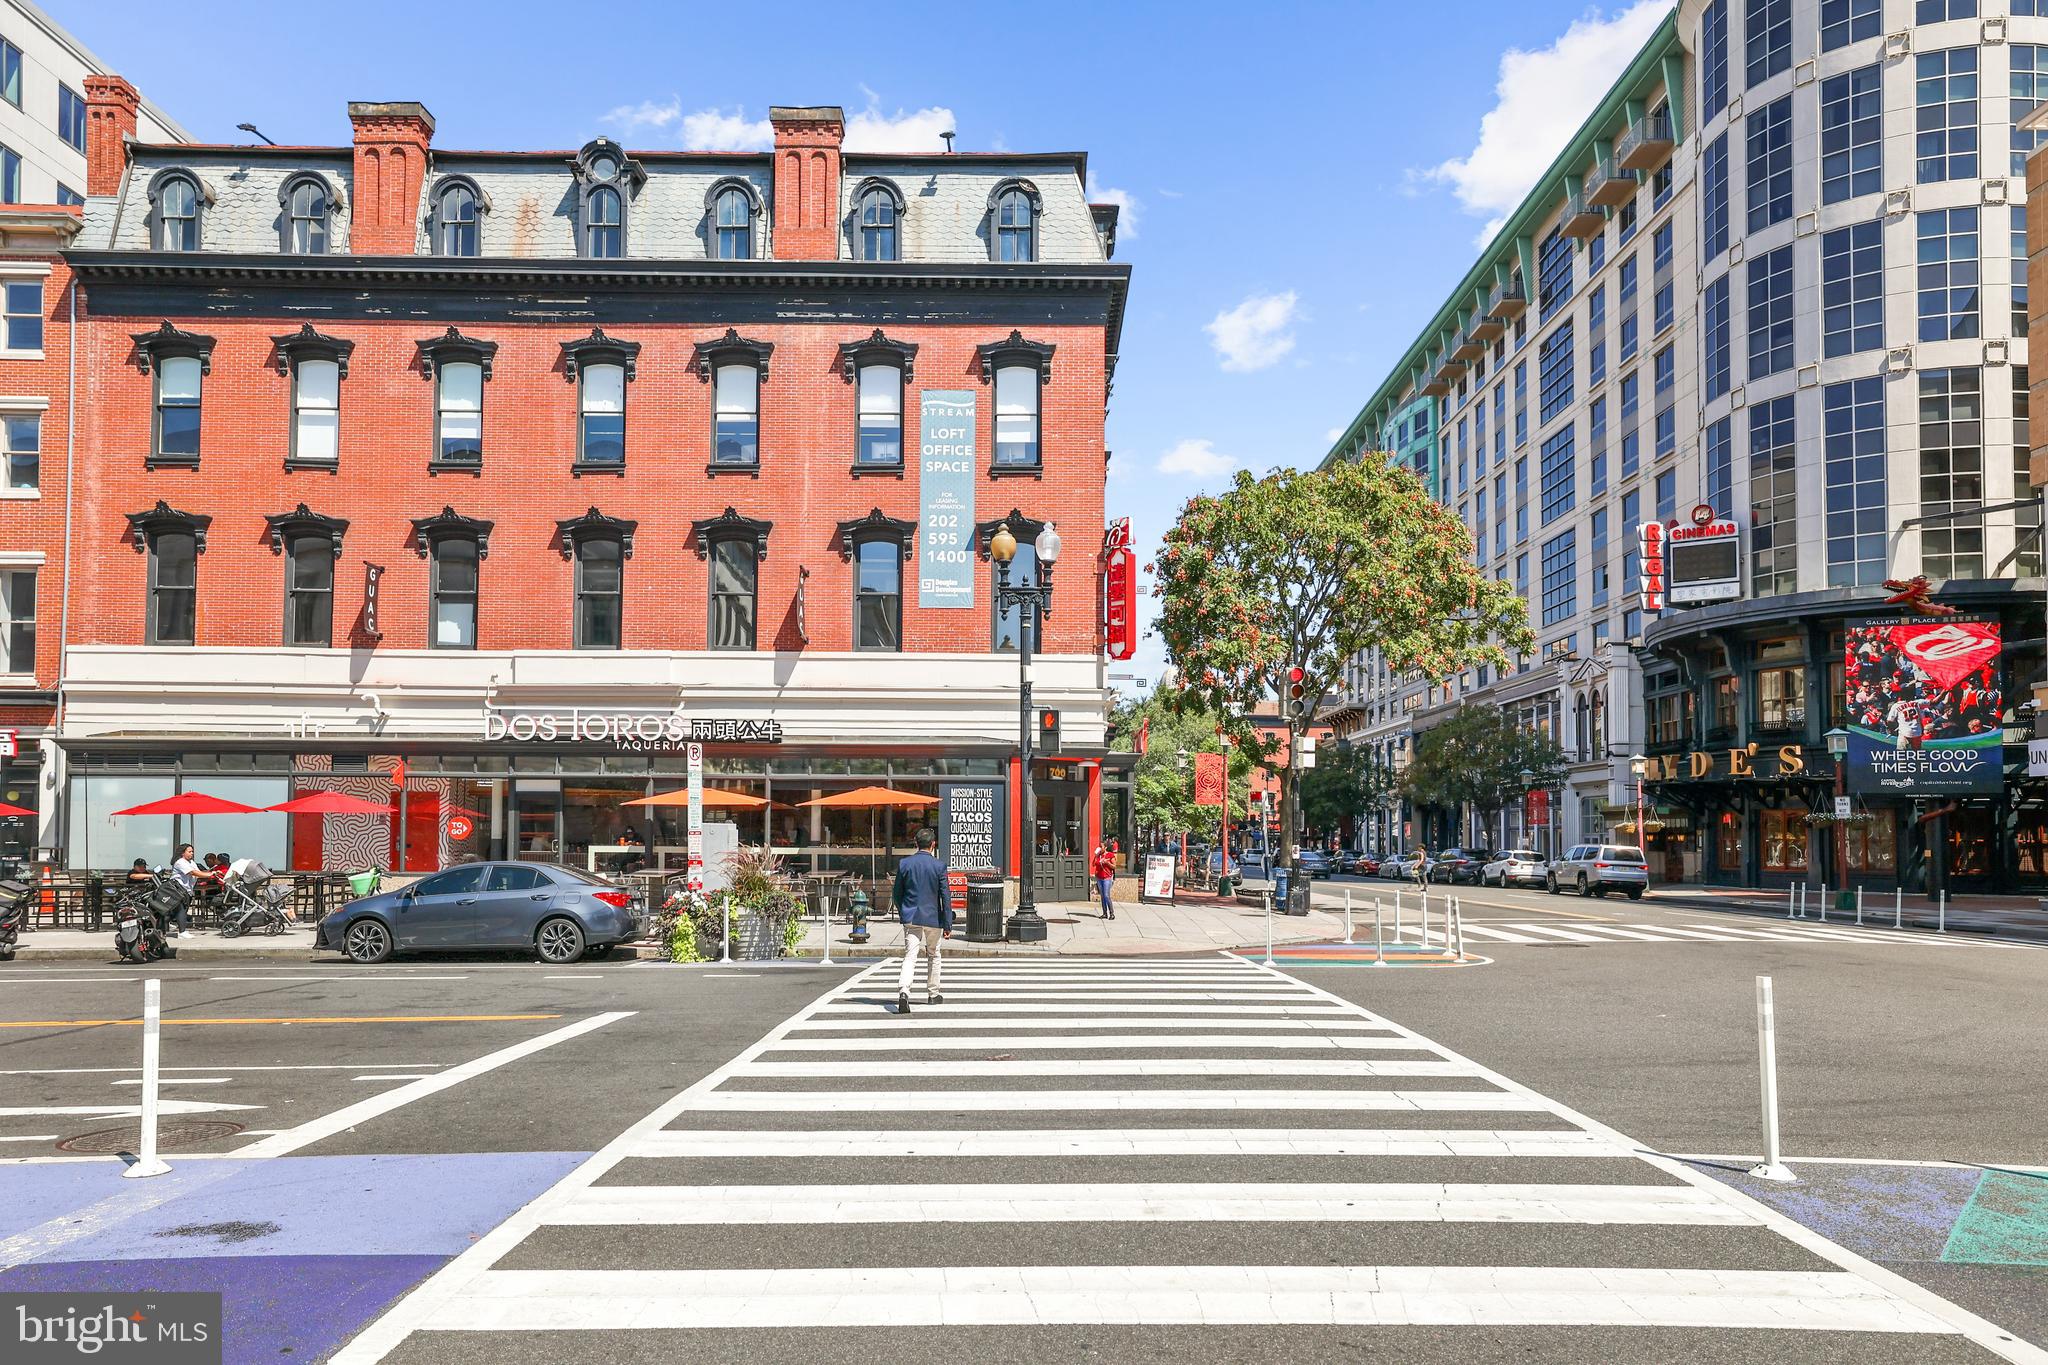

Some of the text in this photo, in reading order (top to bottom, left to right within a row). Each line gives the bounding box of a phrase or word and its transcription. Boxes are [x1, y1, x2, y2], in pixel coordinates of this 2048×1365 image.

[921, 408, 975, 417] STREAM
[930, 428, 966, 440] LOFT
[922, 444, 973, 456] OFFICE
[925, 461, 970, 473] SPACE
[1672, 523, 1736, 540] CINEMAS
[927, 551, 967, 564] 1400
[1646, 524, 1663, 609] REGAL
[367, 568, 376, 631] GUAC
[484, 707, 685, 741] DOS TOROS
[691, 719, 783, 741] 兩頭公牛
[615, 741, 686, 751] TAQUERIA
[1645, 742, 1804, 780] LYDE'S
[1870, 749, 1978, 761] WHERE GOOD
[1049, 767, 1066, 777] 700
[1871, 761, 1987, 773] TIMES FLOW
[950, 788, 993, 798] MISSION-STYLE
[950, 798, 993, 812] BURRITOS
[950, 812, 993, 823] TACOS
[950, 823, 993, 834] QUESADILLAS
[950, 834, 993, 844] BOWLS
[950, 844, 993, 856] BREAKFAST
[950, 856, 993, 867] BURRITOS
